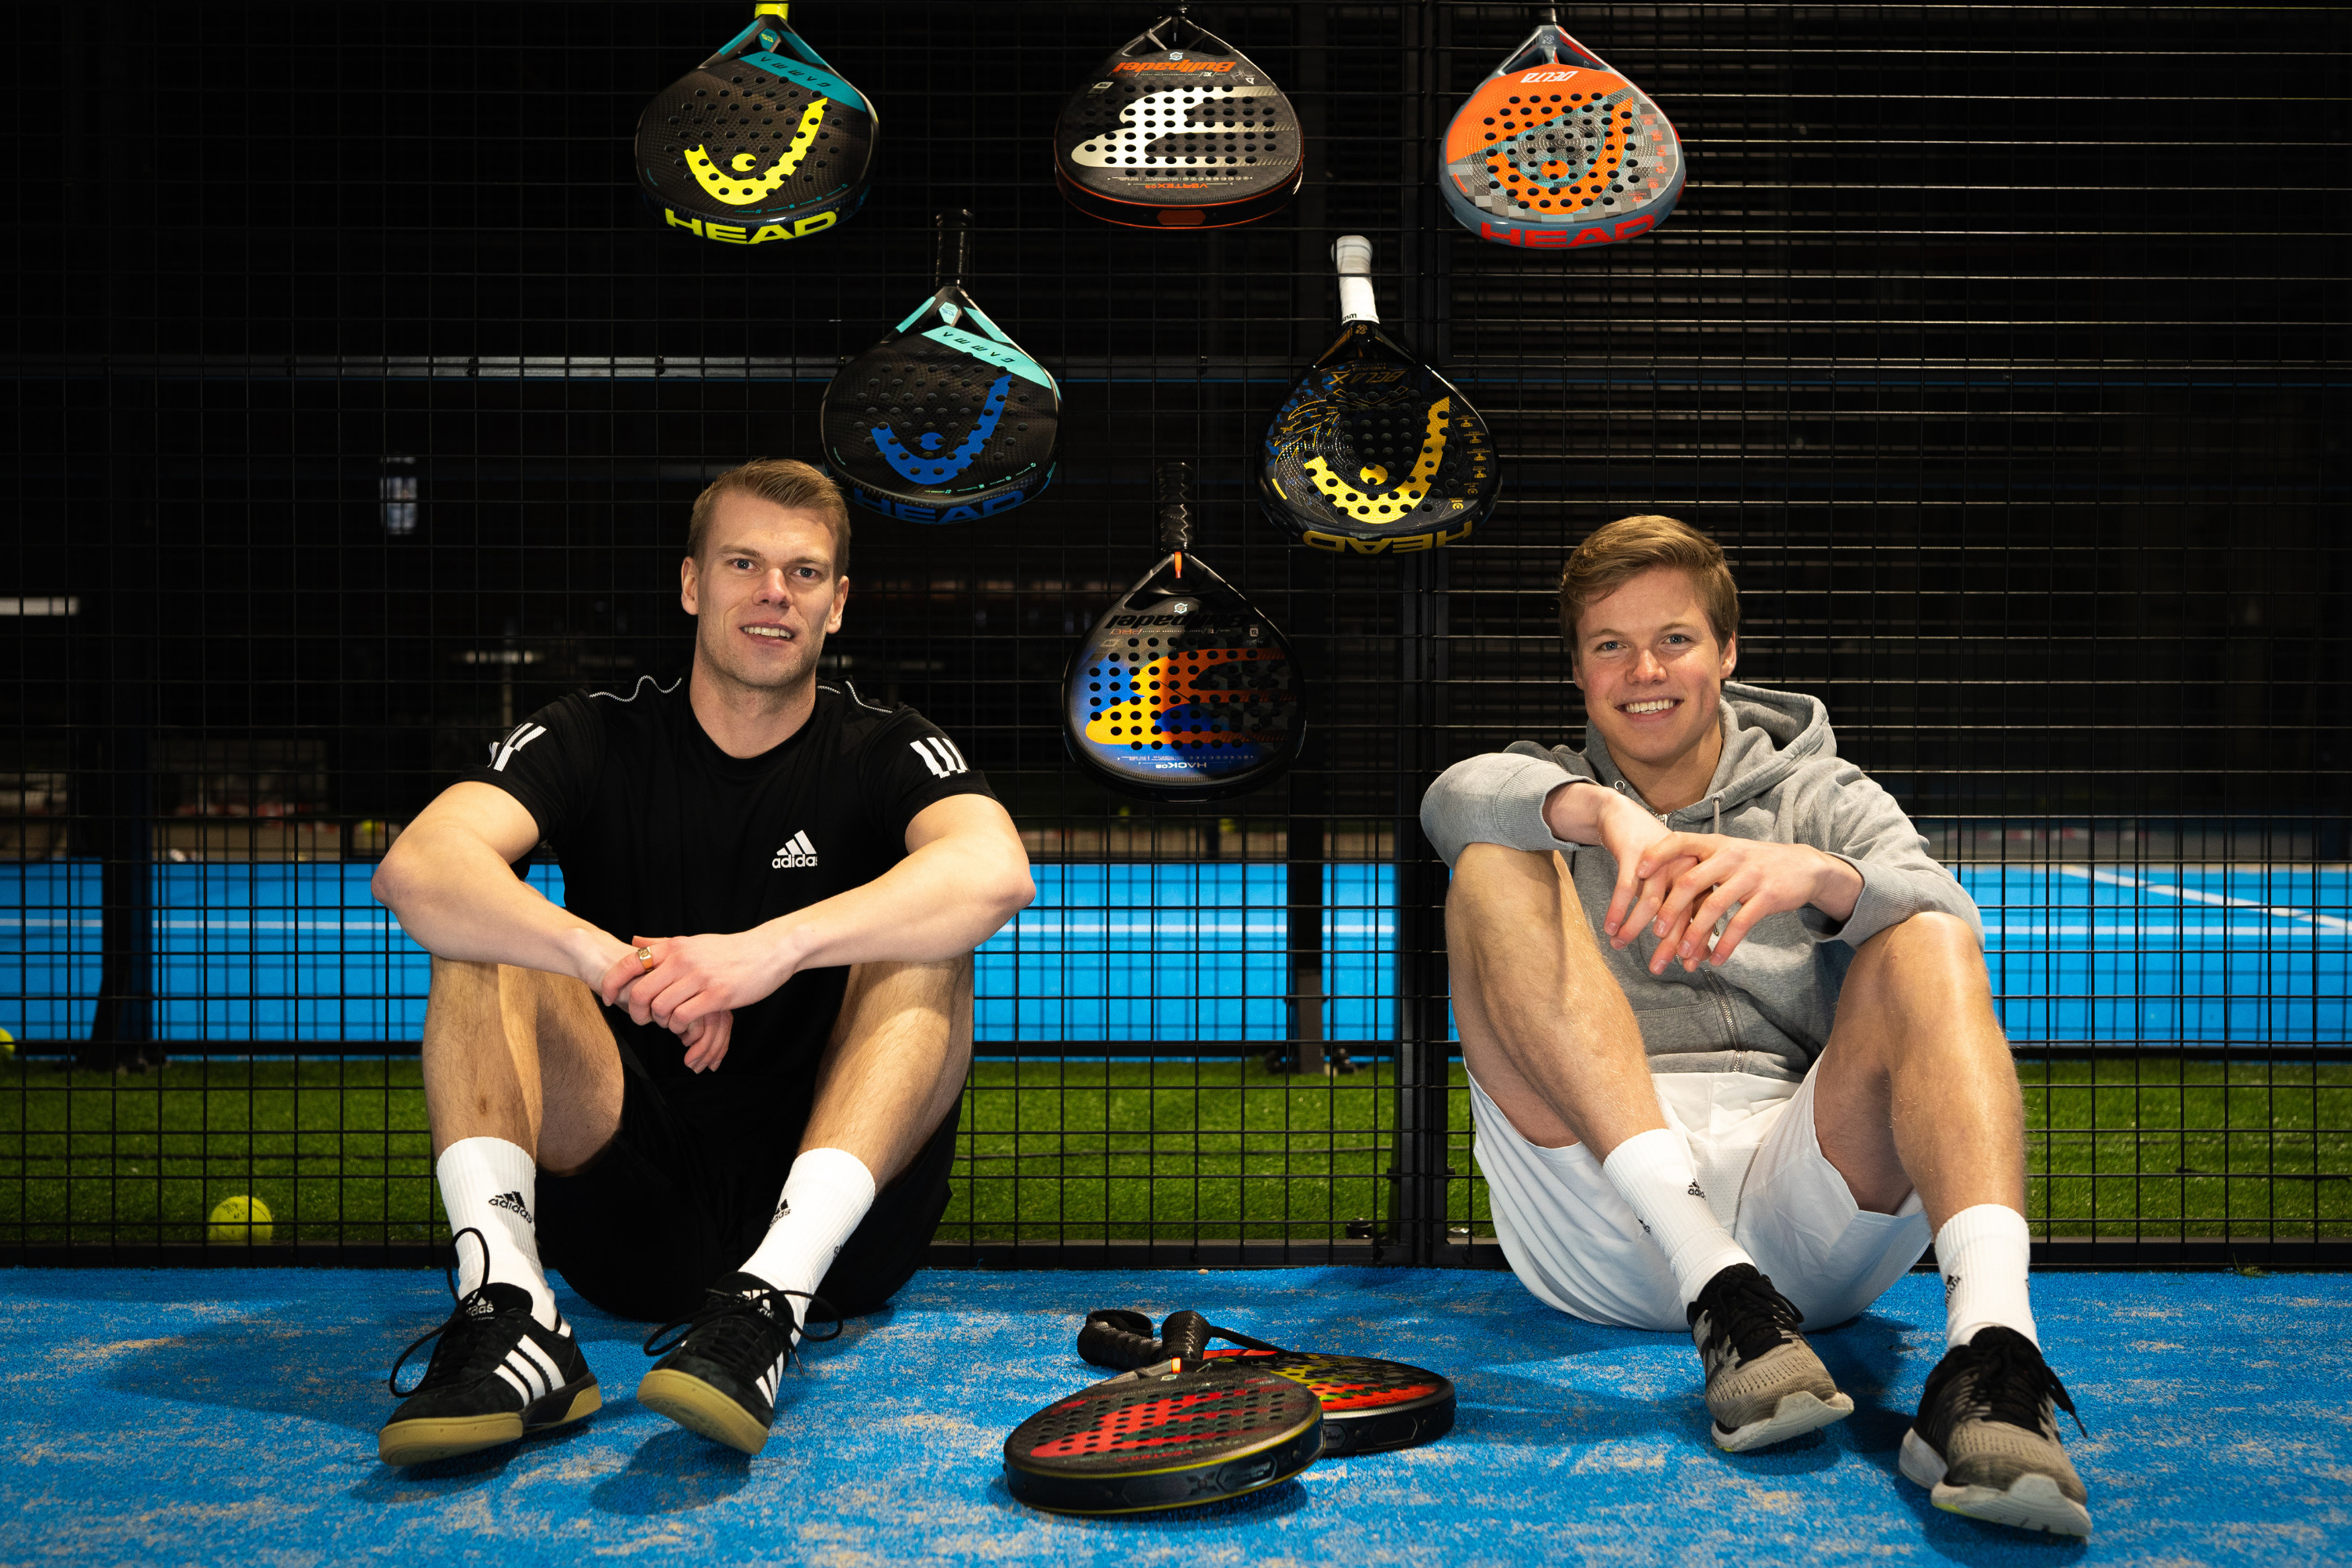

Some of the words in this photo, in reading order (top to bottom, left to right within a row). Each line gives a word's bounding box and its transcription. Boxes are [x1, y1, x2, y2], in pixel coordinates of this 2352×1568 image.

[760, 56, 832, 88] GAMMA
[1112, 59, 1236, 73] Bullpadel
[1520, 71, 1579, 83] DELTA
[666, 208, 837, 245] HEAD
[1480, 215, 1655, 248] HEAD
[942, 331, 1016, 363] GAMMA
[854, 488, 1024, 524] HEAD
[1302, 521, 1472, 554] HEAD
[1105, 612, 1249, 629] Bullpadel
[488, 1199, 532, 1223] adidas
[466, 1304, 494, 1316] das
